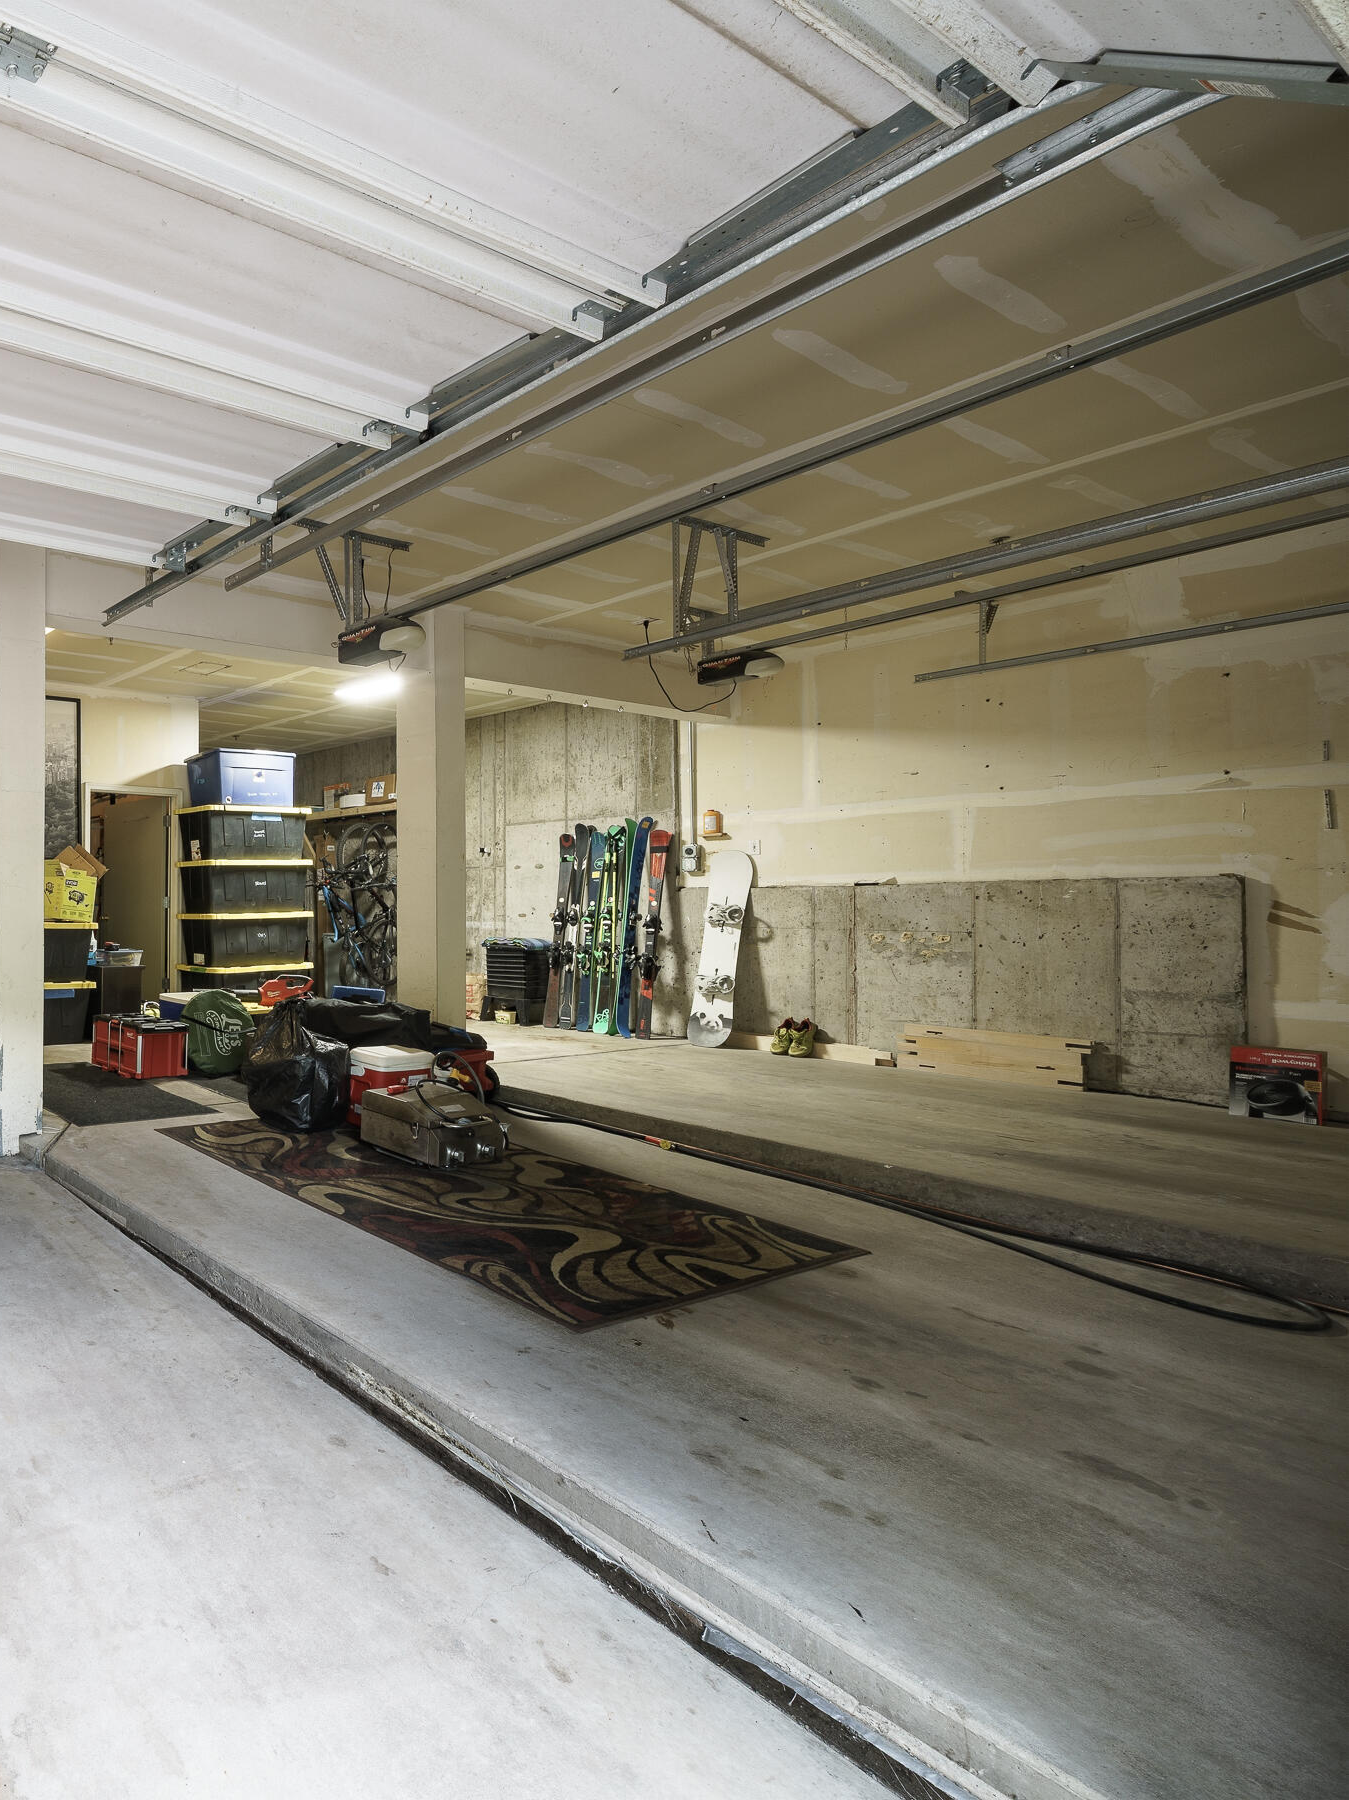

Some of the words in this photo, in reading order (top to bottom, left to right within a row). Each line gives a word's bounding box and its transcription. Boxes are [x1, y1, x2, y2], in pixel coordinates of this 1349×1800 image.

[342, 625, 376, 641] QUANTUM
[702, 655, 741, 668] QUANTUM
[1271, 1058, 1317, 1067] Honeywell
